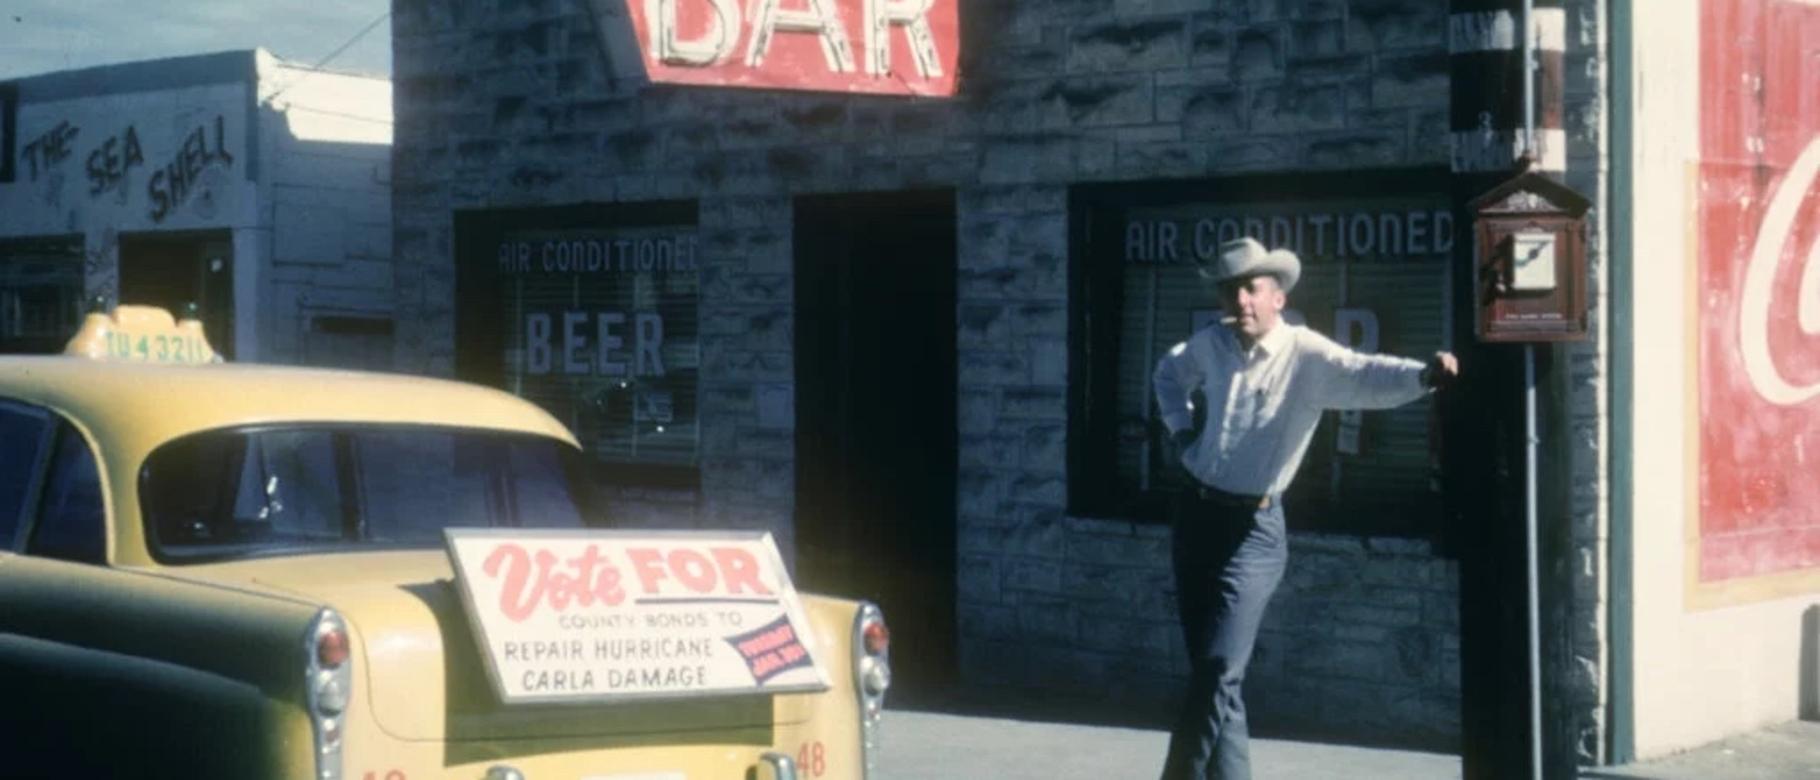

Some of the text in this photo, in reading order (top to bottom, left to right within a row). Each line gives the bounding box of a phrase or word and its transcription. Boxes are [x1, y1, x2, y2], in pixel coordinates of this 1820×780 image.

[644, 0, 943, 78] BAR
[86, 125, 143, 195] SEA
[149, 114, 233, 223] SHELL
[499, 240, 531, 272] AIR
[1125, 219, 1178, 261] AIR
[526, 312, 664, 376] BEER
[483, 543, 775, 620] Vote FOR
[559, 611, 742, 629] COUNTY BONDS TO
[504, 641, 583, 662] REPAIR
[594, 638, 713, 660] HURRICANE
[522, 666, 706, 691] CARLA DAMAGE
[796, 742, 826, 779] 48
